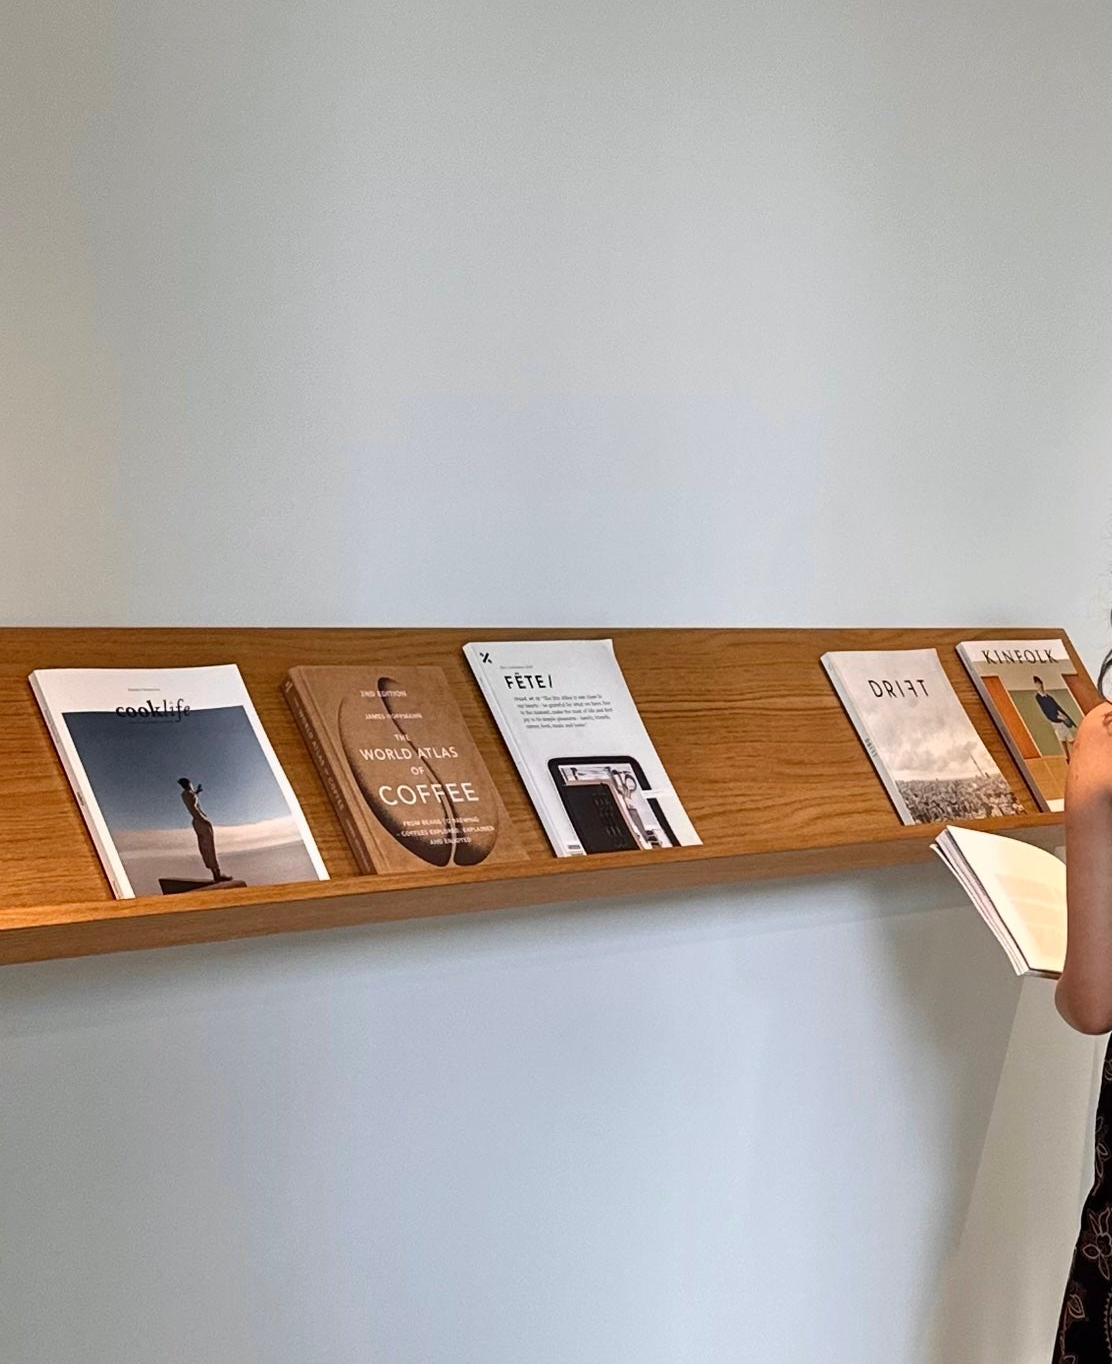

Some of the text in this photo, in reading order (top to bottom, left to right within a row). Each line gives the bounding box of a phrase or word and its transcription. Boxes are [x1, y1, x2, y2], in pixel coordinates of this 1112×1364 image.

[981, 649, 1059, 665] KINFOLK
[376, 690, 407, 698] EDITION
[867, 679, 930, 700] DRIFT
[115, 698, 191, 723] cooklife
[394, 734, 411, 742] THE
[359, 746, 459, 761] WORLD ATLAS
[410, 766, 425, 776] OF
[378, 782, 480, 806] COFFEE
